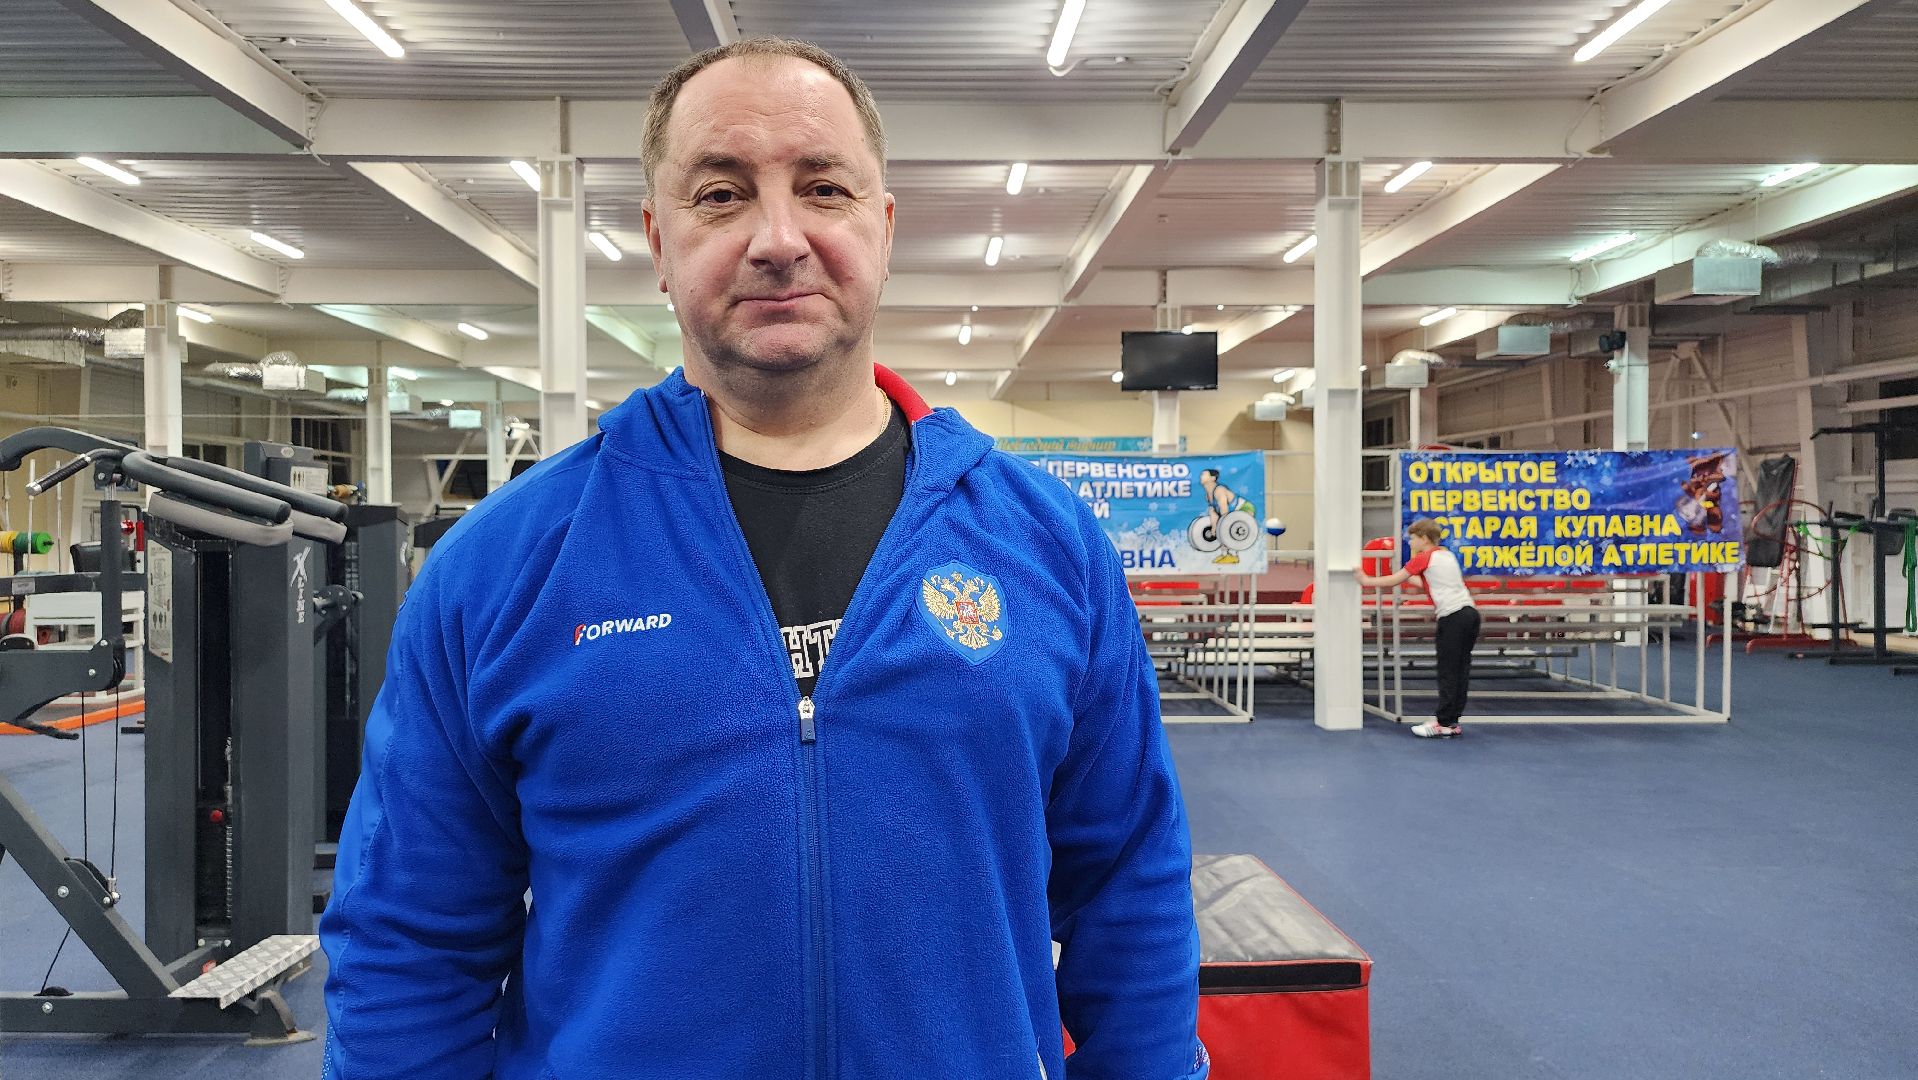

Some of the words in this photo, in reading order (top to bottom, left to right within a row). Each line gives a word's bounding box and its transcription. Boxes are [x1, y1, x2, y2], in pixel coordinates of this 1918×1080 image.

[1048, 461, 1189, 479] ПЕРВЕНСТВО
[1408, 461, 1557, 484] ОТКРЫТОЕ
[1078, 480, 1191, 499] АТЛЕТИКЕ
[1409, 488, 1591, 512] ПЕРВЕНСТВО
[1554, 514, 1682, 538] КУПАВНА
[1459, 541, 1593, 568] ТЯЖЁЛОЙ
[1602, 541, 1740, 566] АТЛЕТИКЕ
[573, 613, 672, 646] FORWARD
